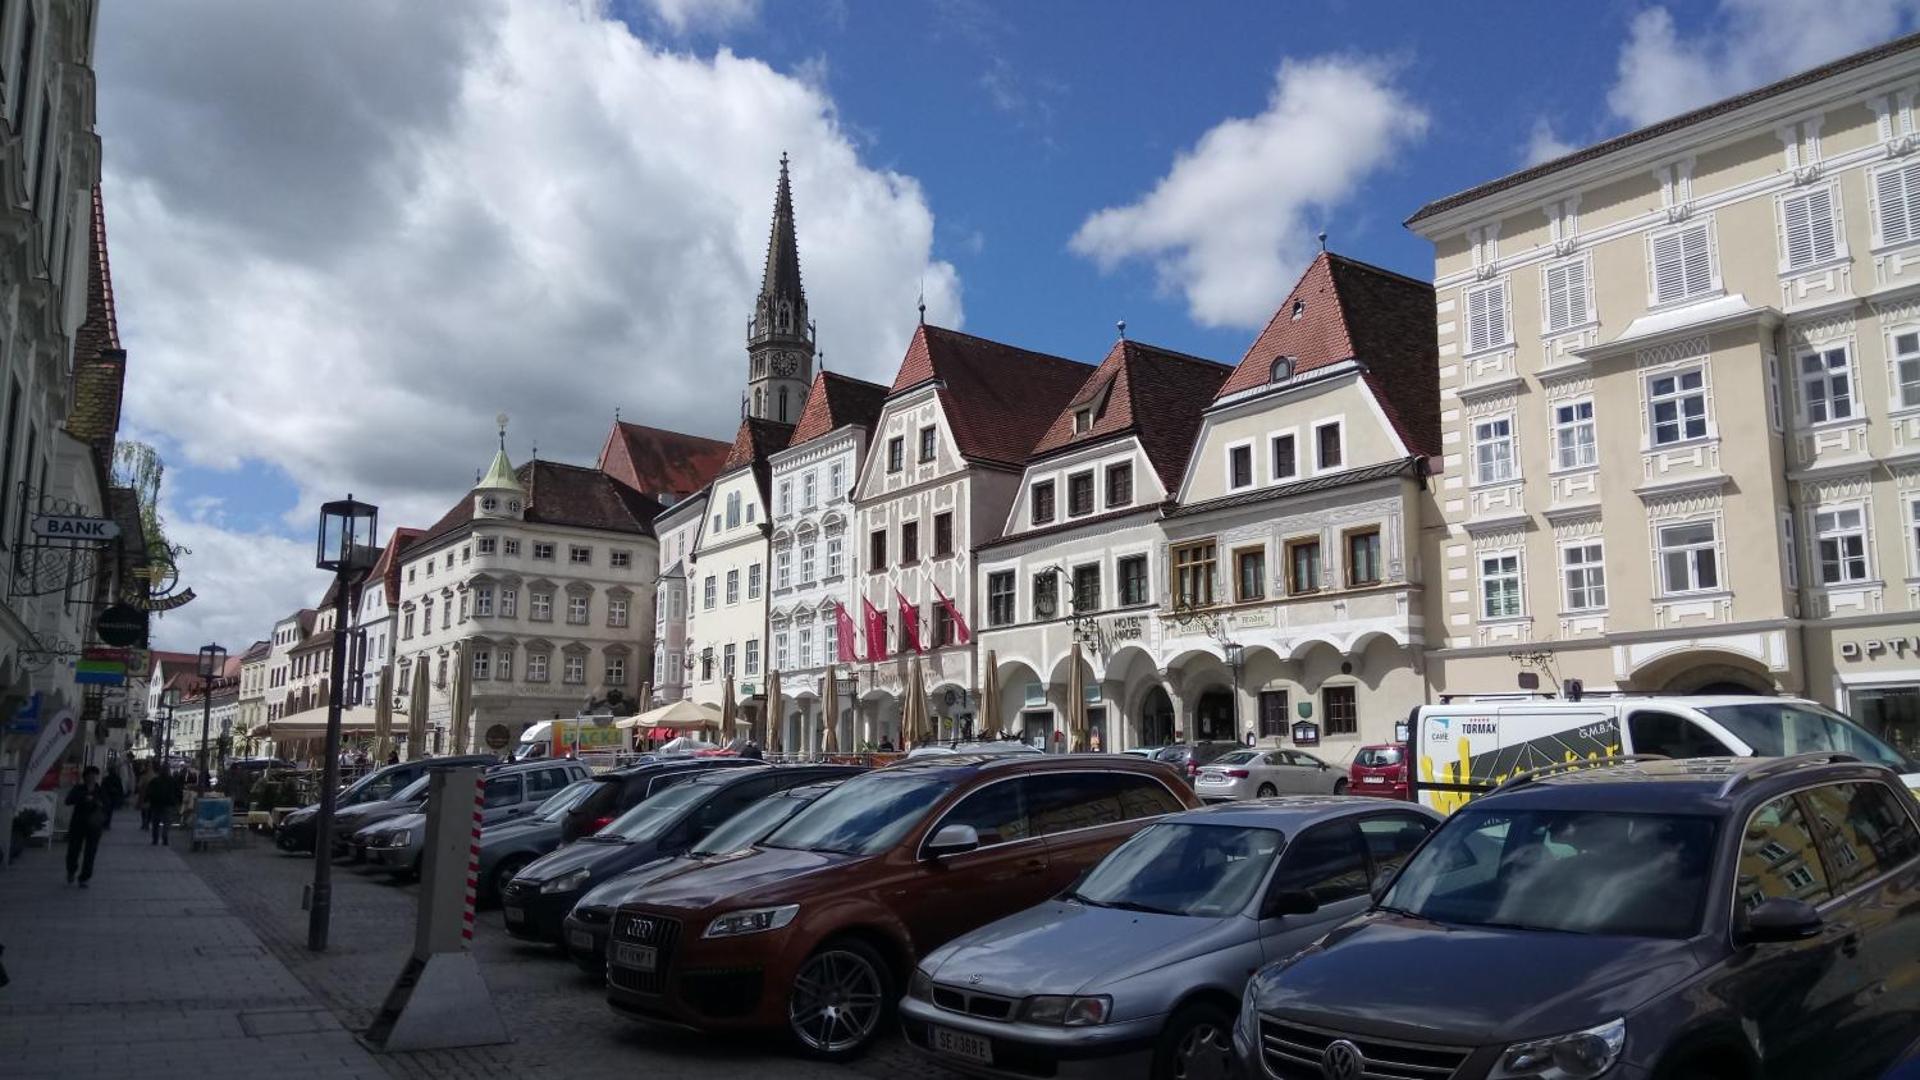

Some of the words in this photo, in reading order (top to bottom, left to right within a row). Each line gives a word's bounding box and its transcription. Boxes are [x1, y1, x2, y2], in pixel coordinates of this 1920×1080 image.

[47, 519, 106, 537] BANK
[1114, 616, 1141, 628] HOTEL
[1462, 722, 1497, 735] TORMAX
